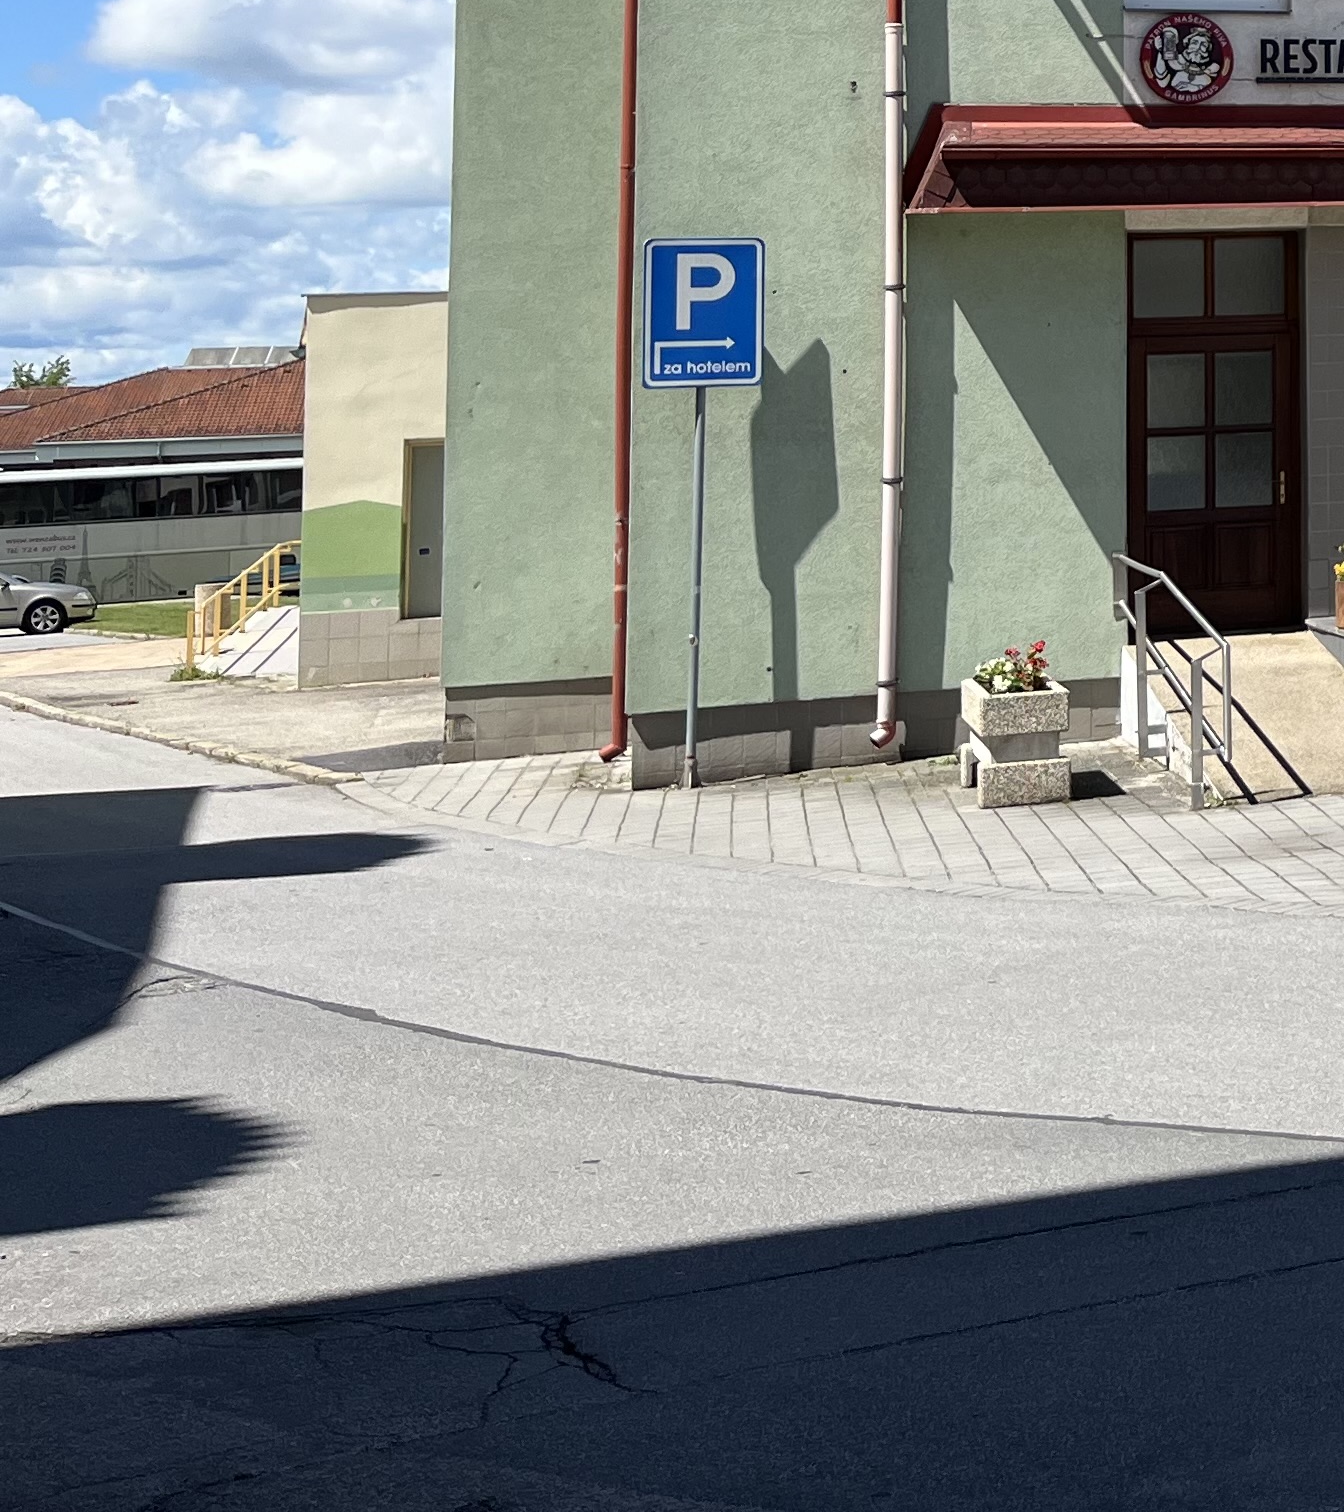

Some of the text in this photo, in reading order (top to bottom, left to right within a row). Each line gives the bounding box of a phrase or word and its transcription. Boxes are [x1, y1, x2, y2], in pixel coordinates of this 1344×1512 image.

[1174, 14, 1212, 29] NAŠEHO
[1164, 84, 1219, 102] GAMBRINUS
[676, 252, 736, 331] P
[663, 360, 751, 375] za hotelem
